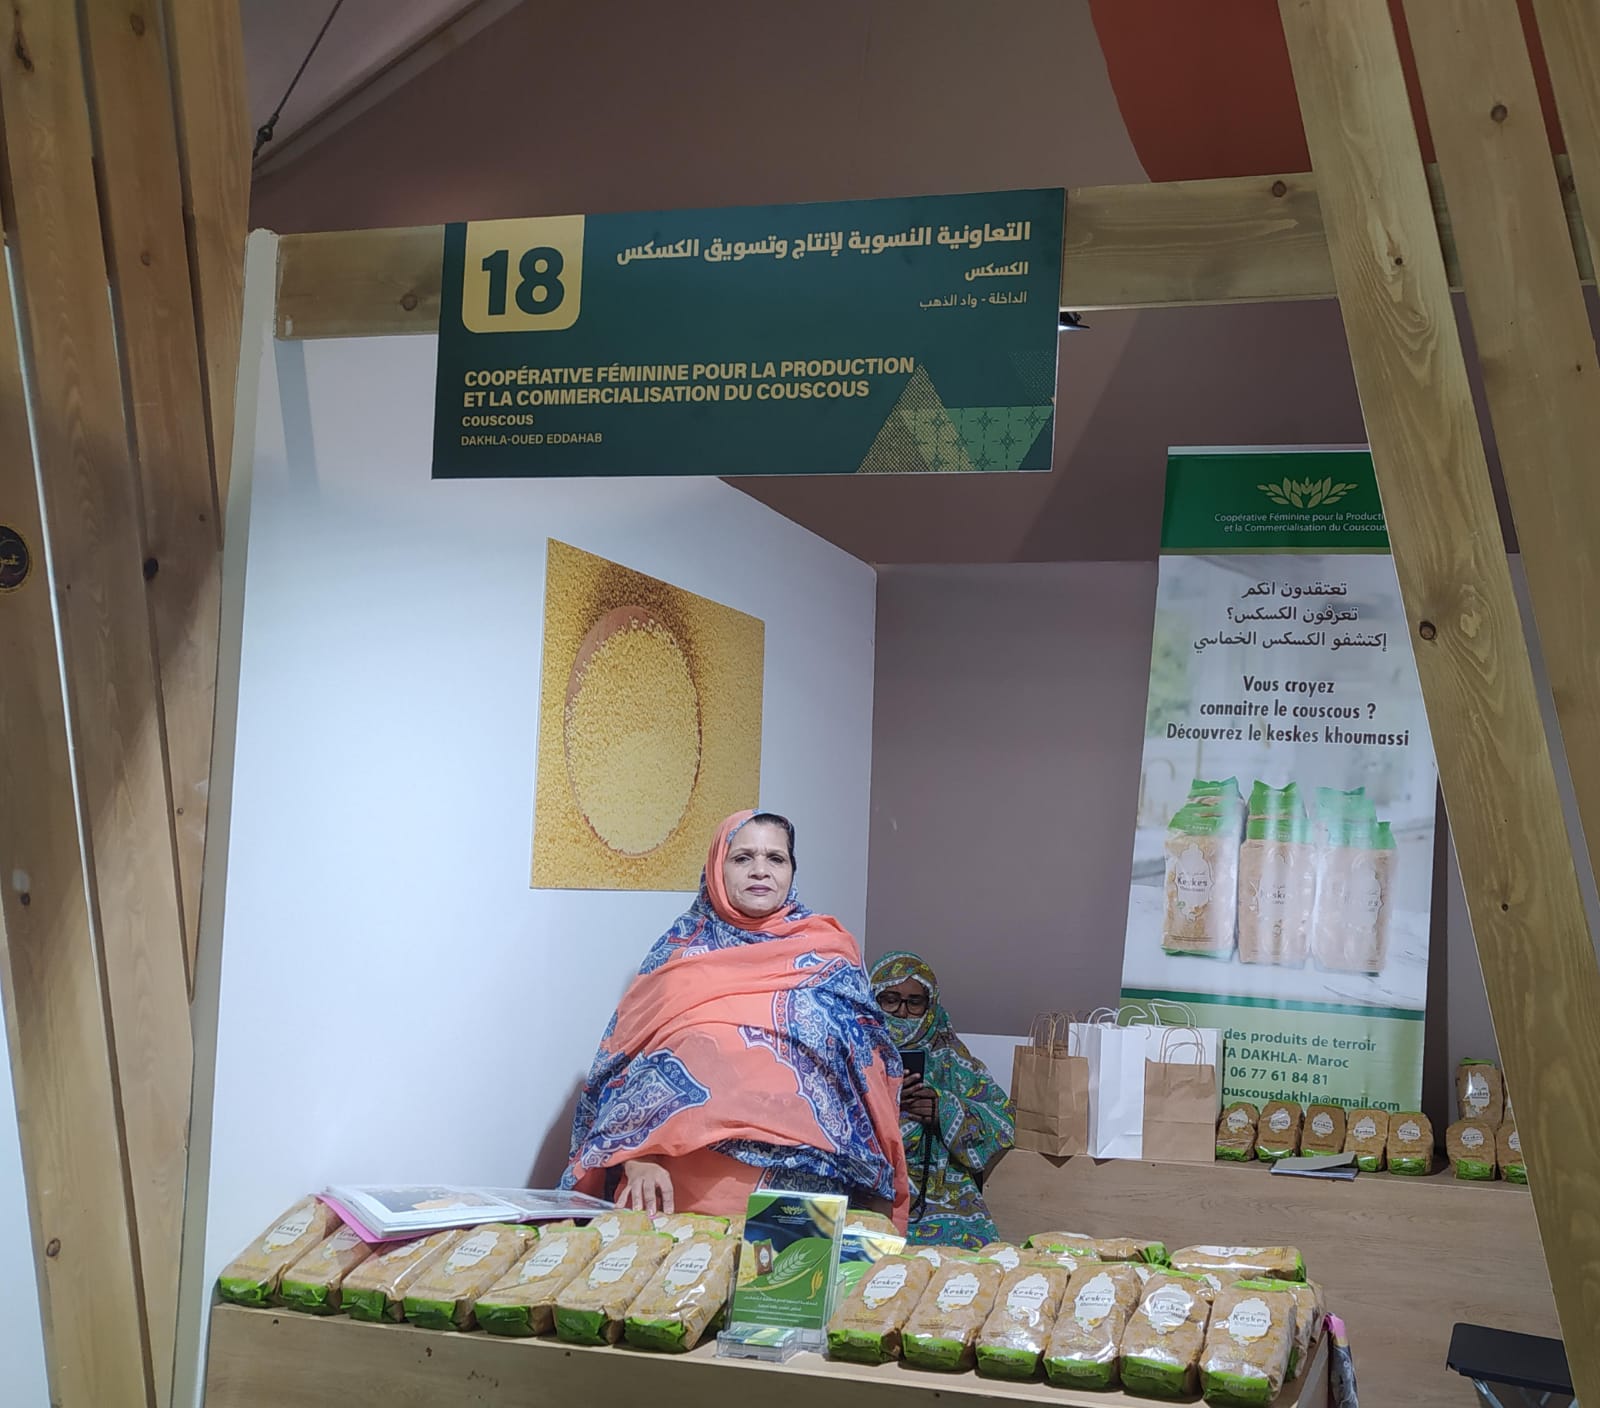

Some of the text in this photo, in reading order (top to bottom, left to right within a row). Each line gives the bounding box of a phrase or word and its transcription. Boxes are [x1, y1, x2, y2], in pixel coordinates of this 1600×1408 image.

[616, 221, 1032, 266] التعاونية النسوية لإنتاج وتسويق الكسكس
[481, 246, 566, 316] 18
[964, 261, 1030, 282] الكسكس
[918, 293, 958, 311] الذهب
[960, 294, 978, 309] واد
[987, 290, 1028, 305] الداخلة
[464, 356, 915, 387] COOPÉRATIVE FÉMININE POUR LA PRODUCTION
[463, 379, 870, 408] ET LA COMMERCIALISATION DU COUSCOUS
[462, 413, 534, 428] COUSCOUS
[461, 431, 603, 447] DAKHLA-OUED EDDAHAB
[1214, 510, 1385, 524] Coopérative Féminine pour la Producti
[1224, 522, 1387, 533] et la Commercialisation du Couscous
[1241, 581, 1348, 599] تعتقدون انكم
[1302, 603, 1359, 626] تعرفون
[1193, 630, 1388, 653] إكتشفو الكسكس الخماسي
[1243, 675, 1335, 698] Vous croyez
[1200, 698, 1377, 720] connaitre le couscous ?
[1166, 722, 1410, 747] Découvrez le keskes khoumassi
[1223, 1027, 1377, 1052] des produits de terroir
[1306, 1053, 1350, 1069] Maroc
[1230, 1065, 1329, 1086] 06 77 61 84 81
[1223, 1085, 1401, 1112] ouscousdakhla@gmail.com
